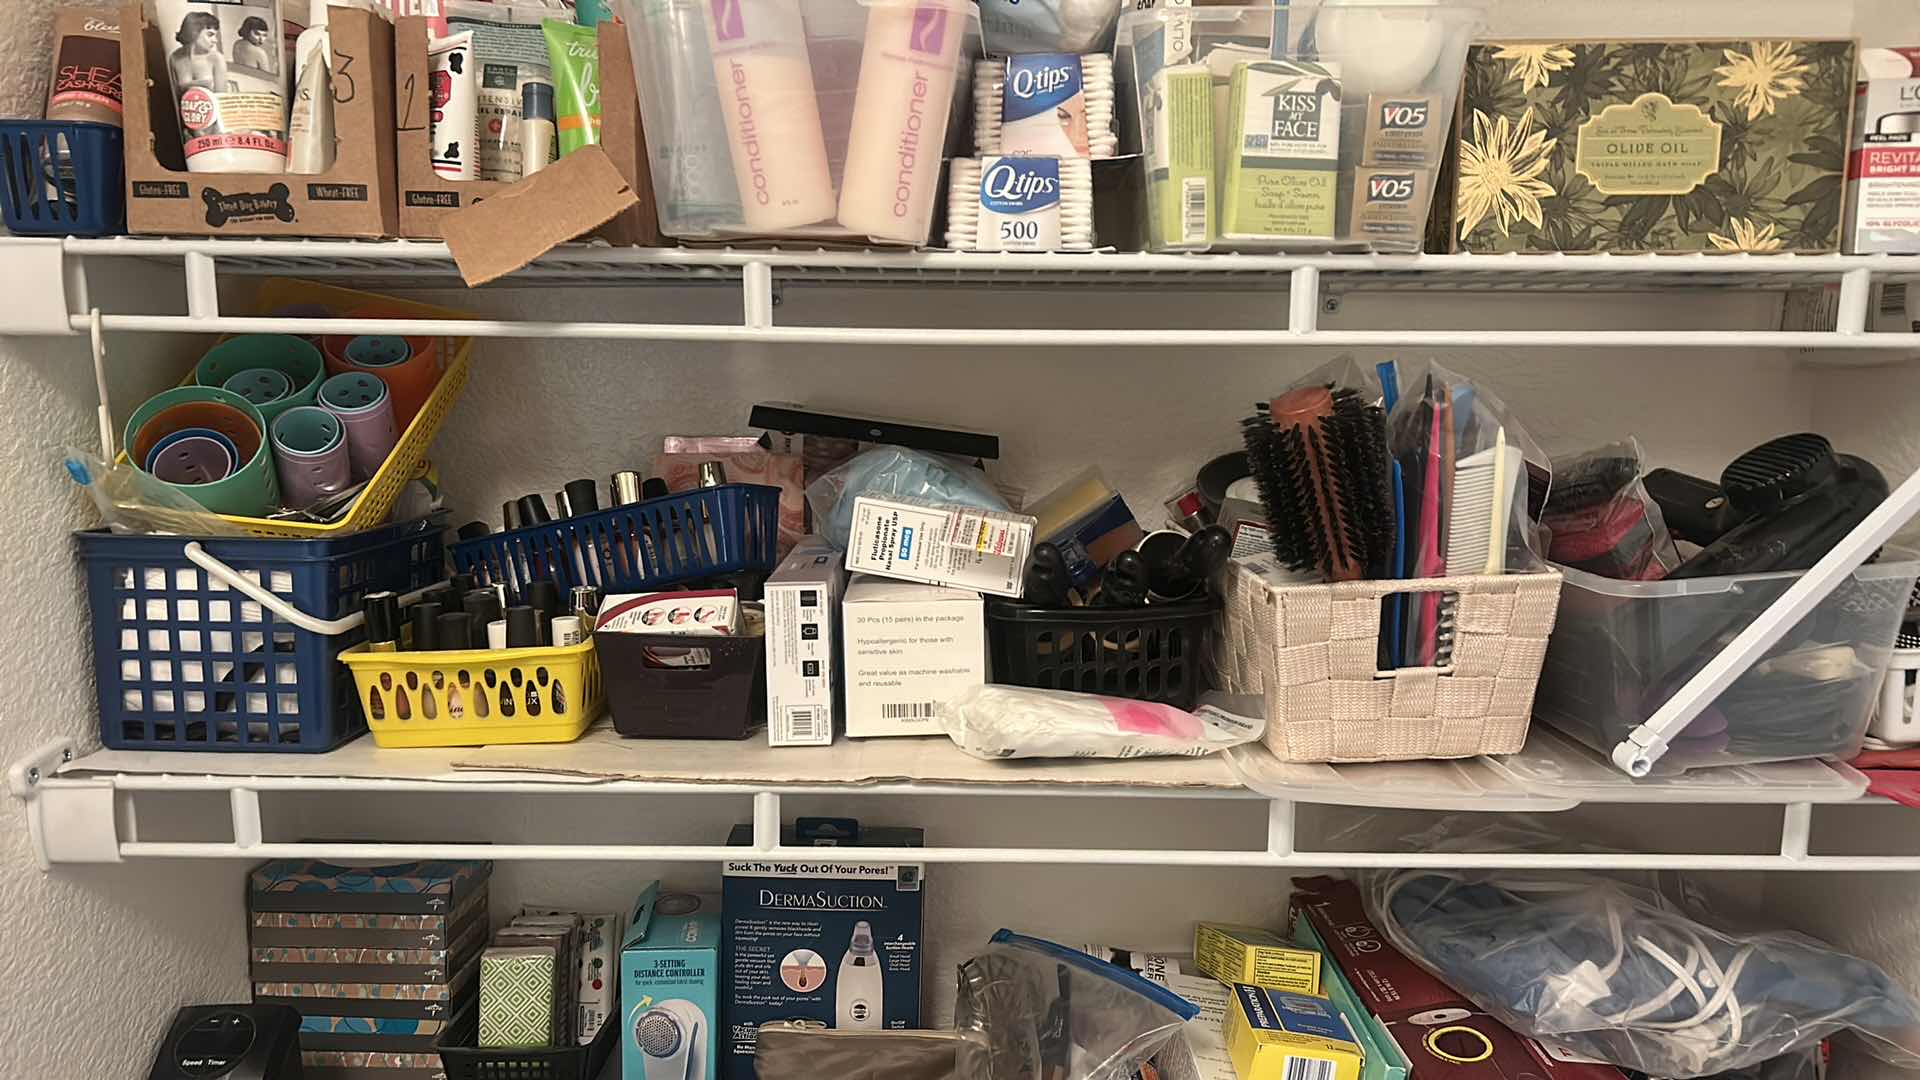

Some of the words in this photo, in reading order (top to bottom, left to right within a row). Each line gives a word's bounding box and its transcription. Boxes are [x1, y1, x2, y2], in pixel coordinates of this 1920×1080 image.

[333, 49, 356, 103] 3
[1278, 95, 1317, 112] KISS
[1289, 112, 1304, 120] MY
[1383, 106, 1427, 125] VO5
[729, 58, 769, 206] conditioner
[1274, 121, 1318, 138] FACE
[237, 136, 251, 146] 8.4
[893, 71, 929, 218] conditioner
[1606, 143, 1654, 154] OLIVE
[1660, 143, 1689, 154] OIL
[1869, 164, 1905, 174] BRIGHT
[1370, 179, 1413, 198] VO5
[1000, 220, 1038, 239] 500
[870, 516, 883, 561] Fluticasone
[878, 519, 890, 560] Propionate
[889, 528, 897, 550] Spray
[902, 529, 913, 545] mcg
[900, 546, 908, 559] 50
[936, 615, 964, 623] package
[728, 862, 752, 873] Suck
[753, 863, 771, 873] The
[773, 863, 798, 874] Yuck
[800, 864, 819, 874] Out
[820, 864, 834, 874] Of
[834, 864, 857, 875] Your
[897, 934, 904, 942] 4
[634, 970, 665, 978] DISTANCE
[666, 968, 705, 978] CONTROLLER
[182, 1059, 203, 1068] Speed
